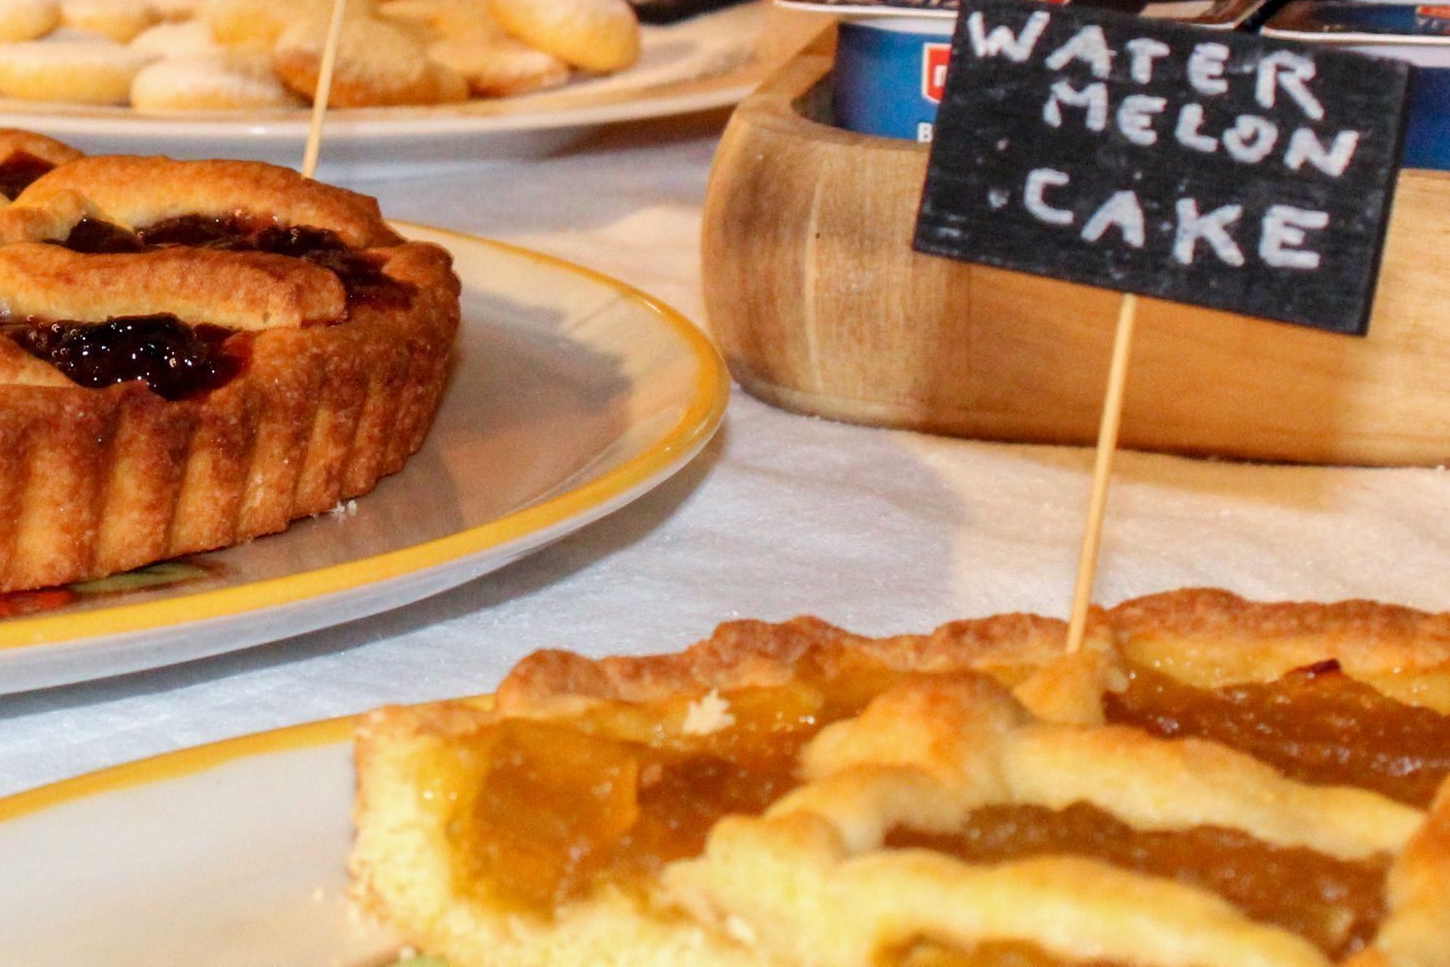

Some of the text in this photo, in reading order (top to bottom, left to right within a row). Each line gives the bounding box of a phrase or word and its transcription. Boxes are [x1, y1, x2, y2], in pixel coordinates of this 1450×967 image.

[966, 10, 1325, 121] WATER
[1042, 80, 1360, 177] MELON
[1023, 169, 1329, 270] CAKE
